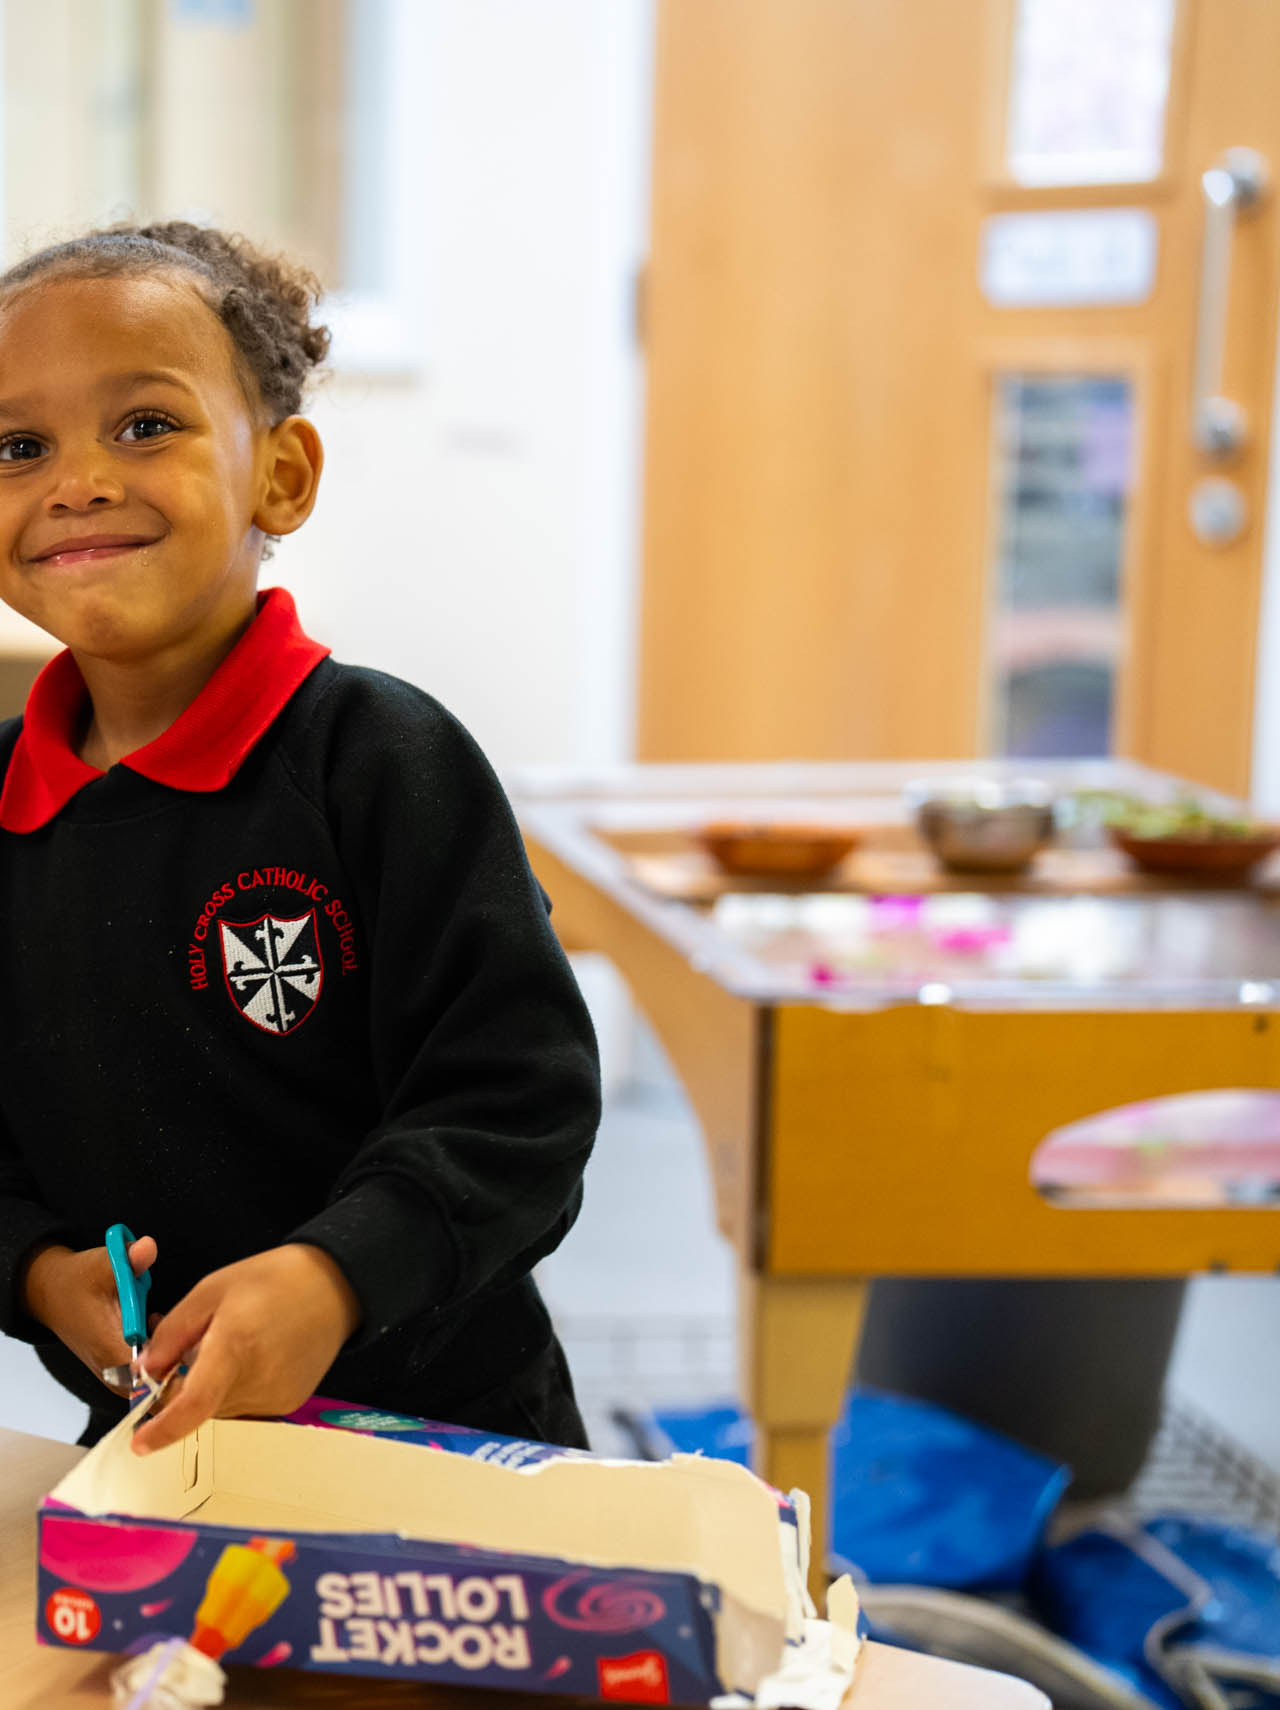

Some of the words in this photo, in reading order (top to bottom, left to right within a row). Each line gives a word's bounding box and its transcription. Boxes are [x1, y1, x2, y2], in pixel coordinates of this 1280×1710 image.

[237, 867, 329, 901] CATHOLIC
[194, 882, 236, 941] CROSS
[324, 899, 358, 976] SCHOOL
[187, 943, 209, 990] HOLY
[314, 1571, 531, 1622] LOLLIES
[54, 1607, 91, 1640] 10
[310, 1617, 532, 1671] ROCKET
